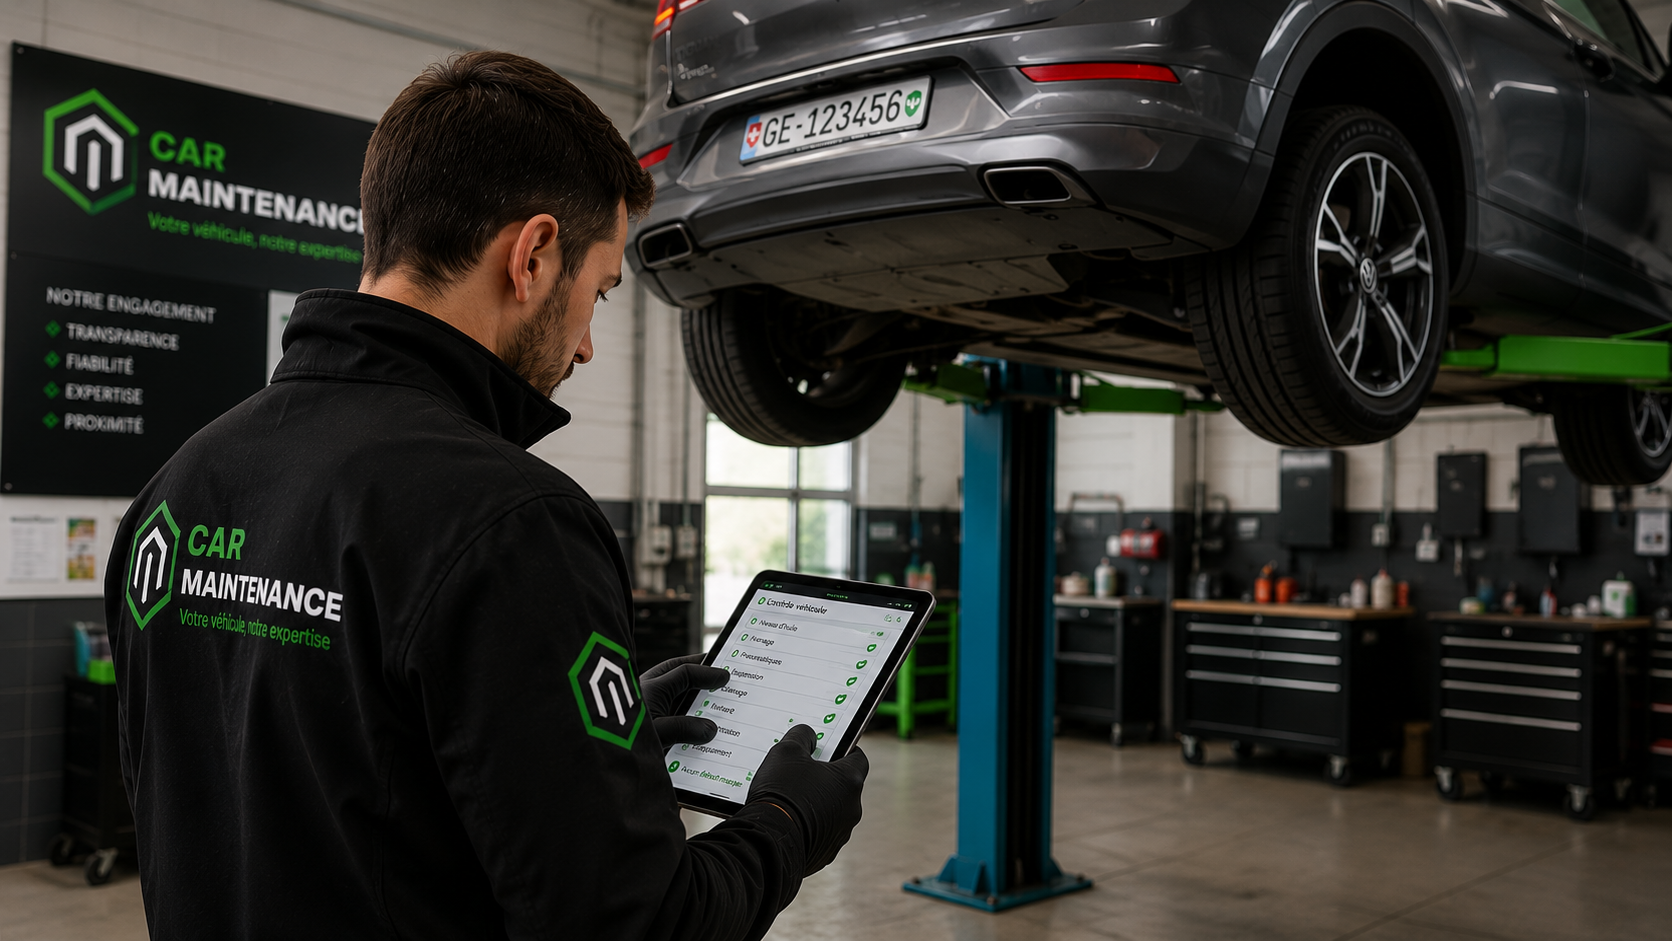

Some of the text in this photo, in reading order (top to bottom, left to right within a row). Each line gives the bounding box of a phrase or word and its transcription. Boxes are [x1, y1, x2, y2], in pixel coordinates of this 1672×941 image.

[763, 90, 903, 148] GE-123456
[149, 131, 226, 172] CAR
[148, 169, 365, 235] MAINTENANC
[147, 211, 190, 236] Votre
[46, 286, 216, 323] NOTRE ENGAGEMENT
[66, 322, 180, 351] TRANSPARENCE
[65, 352, 134, 375] FIABILITÉ
[65, 382, 143, 405] EXPERTISE
[187, 524, 246, 560] CAR
[181, 568, 344, 622] MAINTENANCE
[179, 607, 331, 650] Votre véhicule, notre expertise
